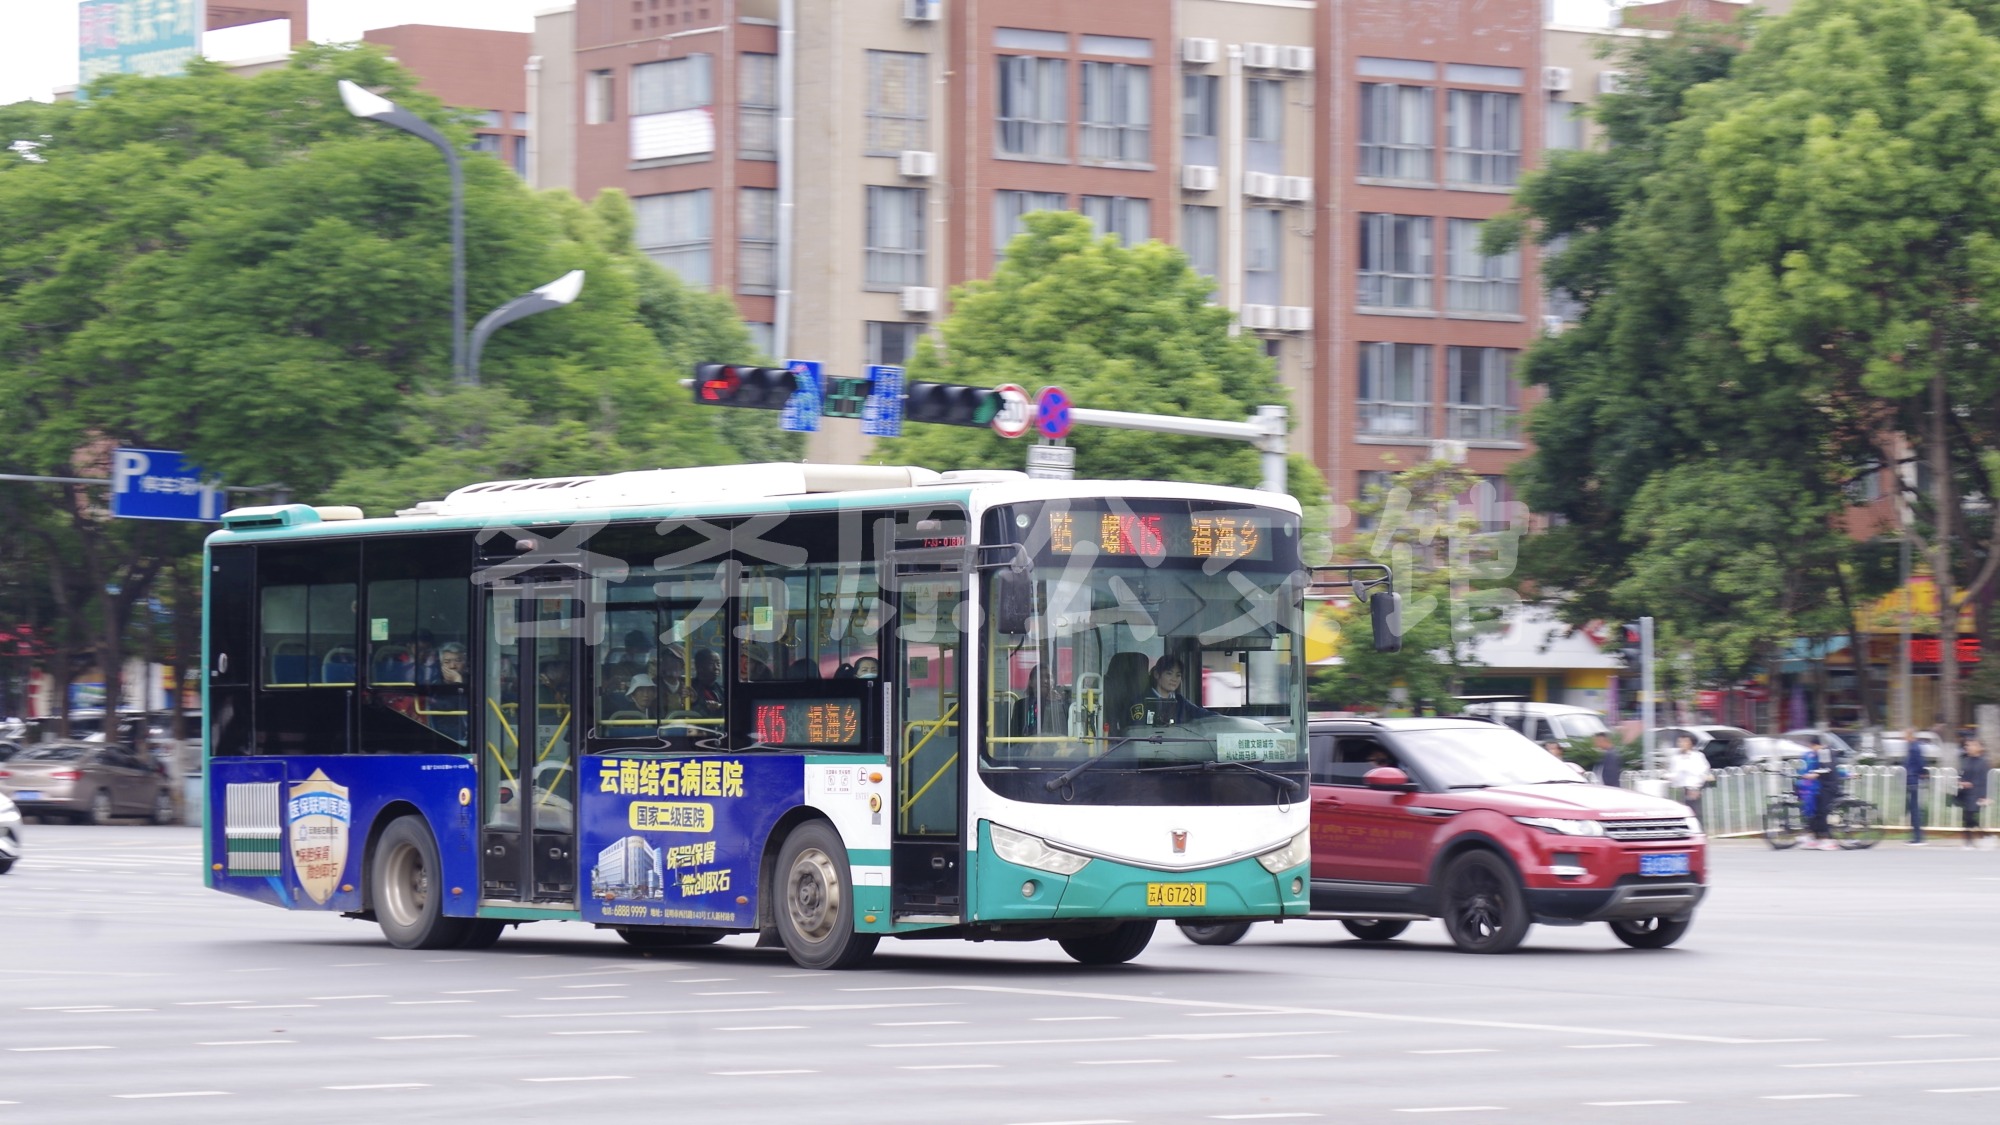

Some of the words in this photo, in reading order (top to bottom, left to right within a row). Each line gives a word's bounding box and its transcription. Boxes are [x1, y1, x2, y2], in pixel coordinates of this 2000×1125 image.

[113, 452, 150, 493] P
[1120, 516, 1163, 554] K15
[1191, 517, 1259, 556] 福海乡
[757, 705, 786, 743] K15
[807, 703, 857, 743] 福海乡
[600, 759, 743, 797] 云南结石病医院
[637, 805, 705, 828] 国家二级医院
[681, 869, 731, 897] 微创取石
